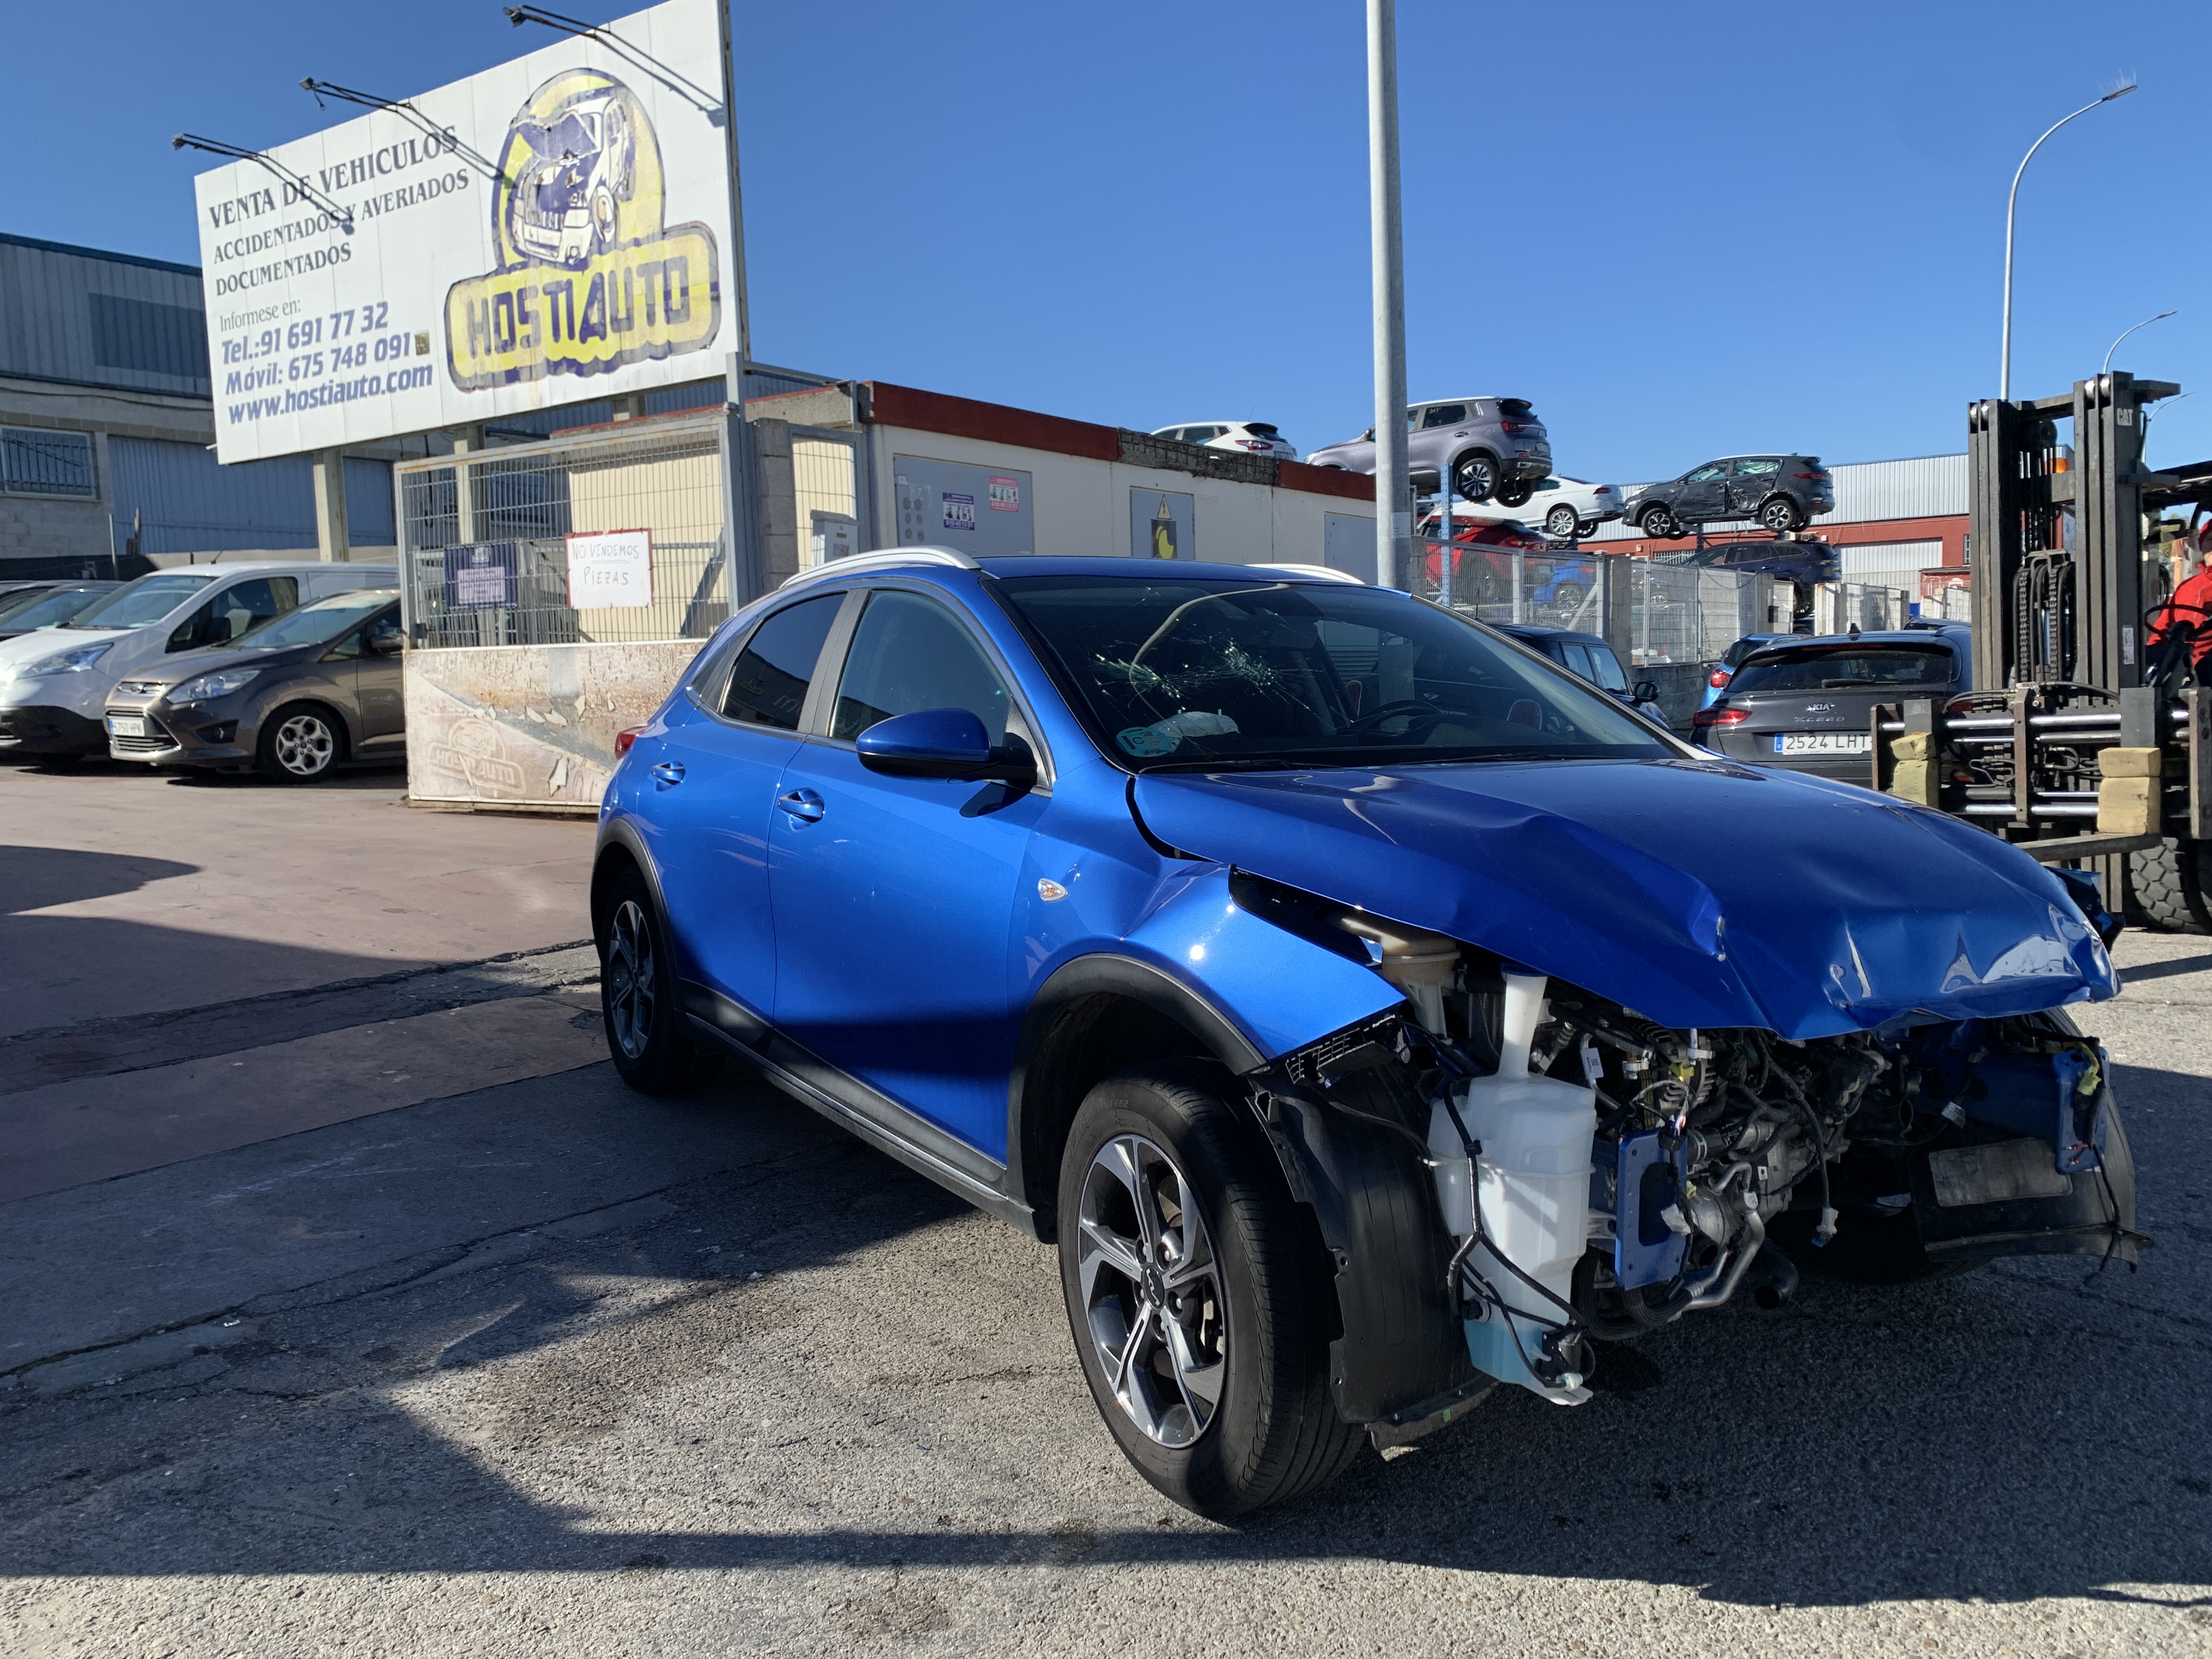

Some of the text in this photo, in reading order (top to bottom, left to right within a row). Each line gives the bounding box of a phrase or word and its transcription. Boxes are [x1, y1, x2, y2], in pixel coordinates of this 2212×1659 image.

[209, 125, 456, 229] VENTA DE VEHICULOS
[214, 210, 340, 265] ACCIDENTADOS
[362, 168, 469, 221] AVERIADOS
[215, 242, 352, 297] DOCUMENTADOS
[219, 299, 302, 332] Informese en:
[287, 317, 323, 350] 691
[330, 309, 356, 340] 77
[360, 300, 388, 334] 32
[467, 257, 690, 359] HOSTIAUTO
[225, 331, 410, 396] Móvil: 675 748 091
[228, 364, 433, 425] www.hostiauto.com
[2117, 408, 2134, 426] CAT
[572, 541, 639, 560] NO VENDEMOS
[1812, 703, 1831, 712] KIA
[1786, 733, 1869, 750] 2524 LHT
